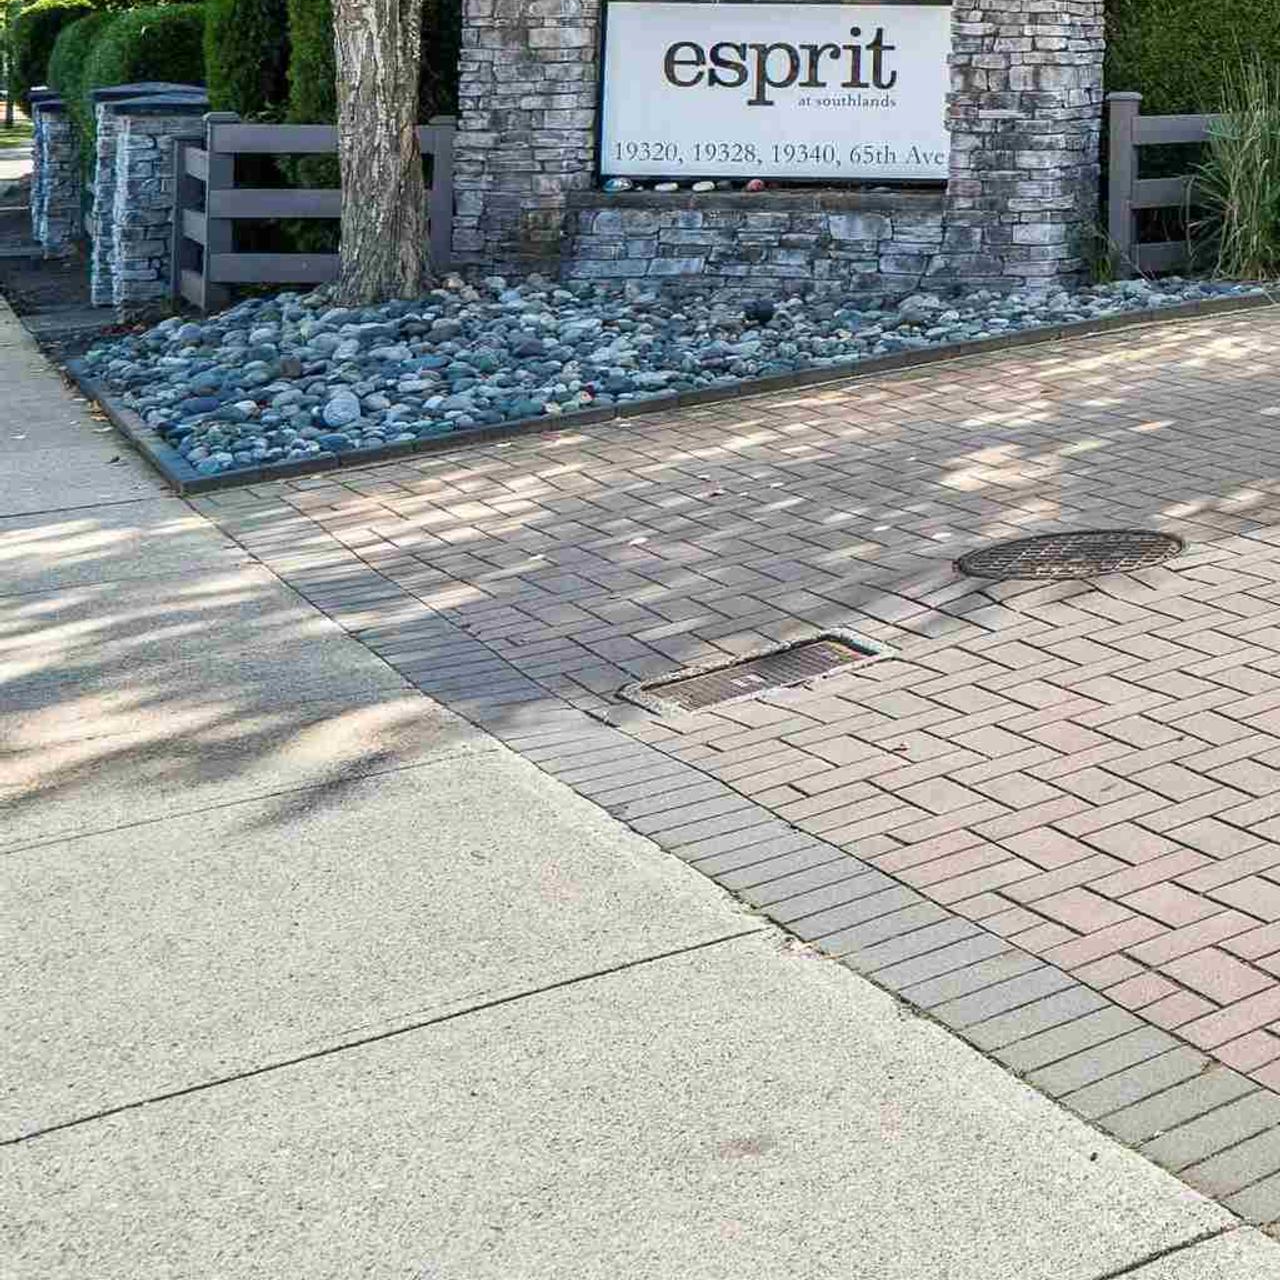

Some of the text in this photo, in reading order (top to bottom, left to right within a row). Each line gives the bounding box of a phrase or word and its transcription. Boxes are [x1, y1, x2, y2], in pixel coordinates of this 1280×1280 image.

[663, 26, 897, 106] esprit
[799, 93, 897, 107] at southlands
[614, 141, 684, 164] 19320,
[693, 142, 763, 165] 19328,
[771, 144, 842, 167] 19340,
[849, 144, 897, 165] 65th
